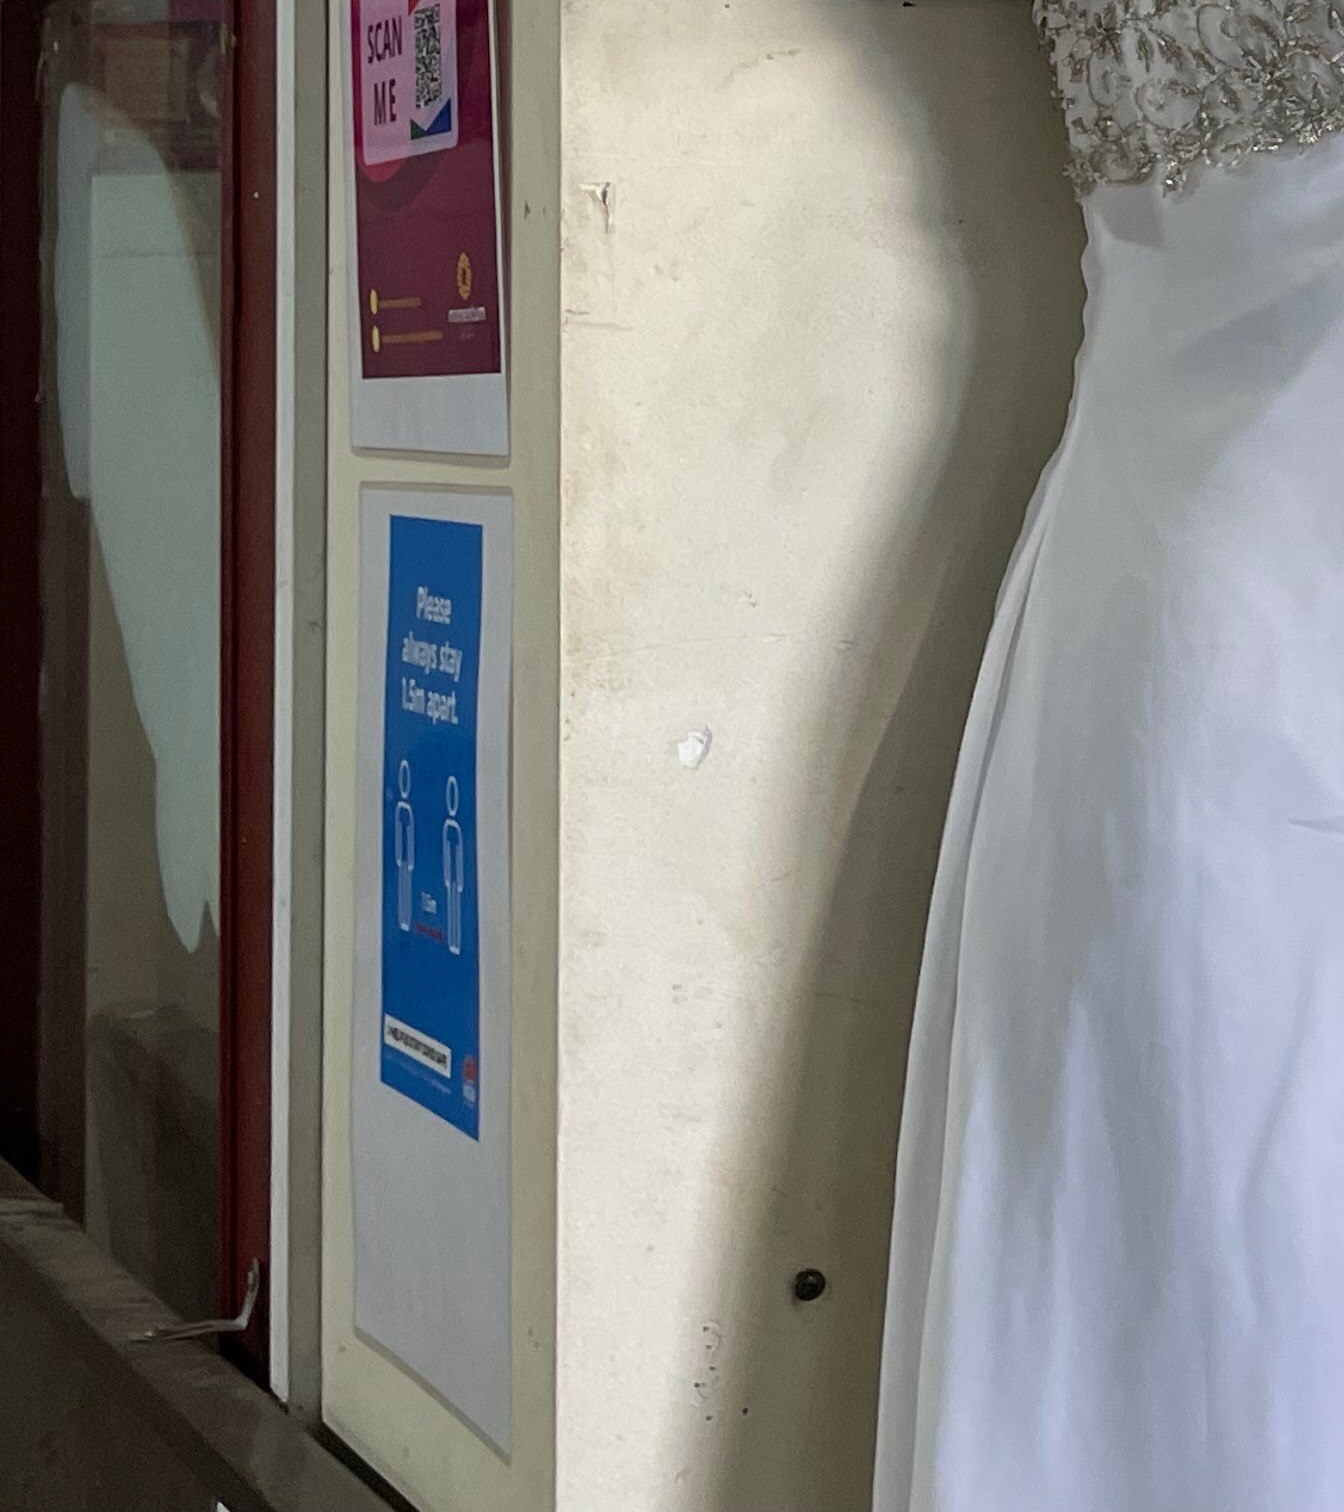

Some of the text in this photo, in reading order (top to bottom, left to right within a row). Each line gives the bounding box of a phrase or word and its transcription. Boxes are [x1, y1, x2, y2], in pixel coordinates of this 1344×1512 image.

[367, 14, 402, 63] SCAN
[374, 78, 396, 125] ME
[416, 586, 452, 625] Please
[401, 630, 463, 683] always stay
